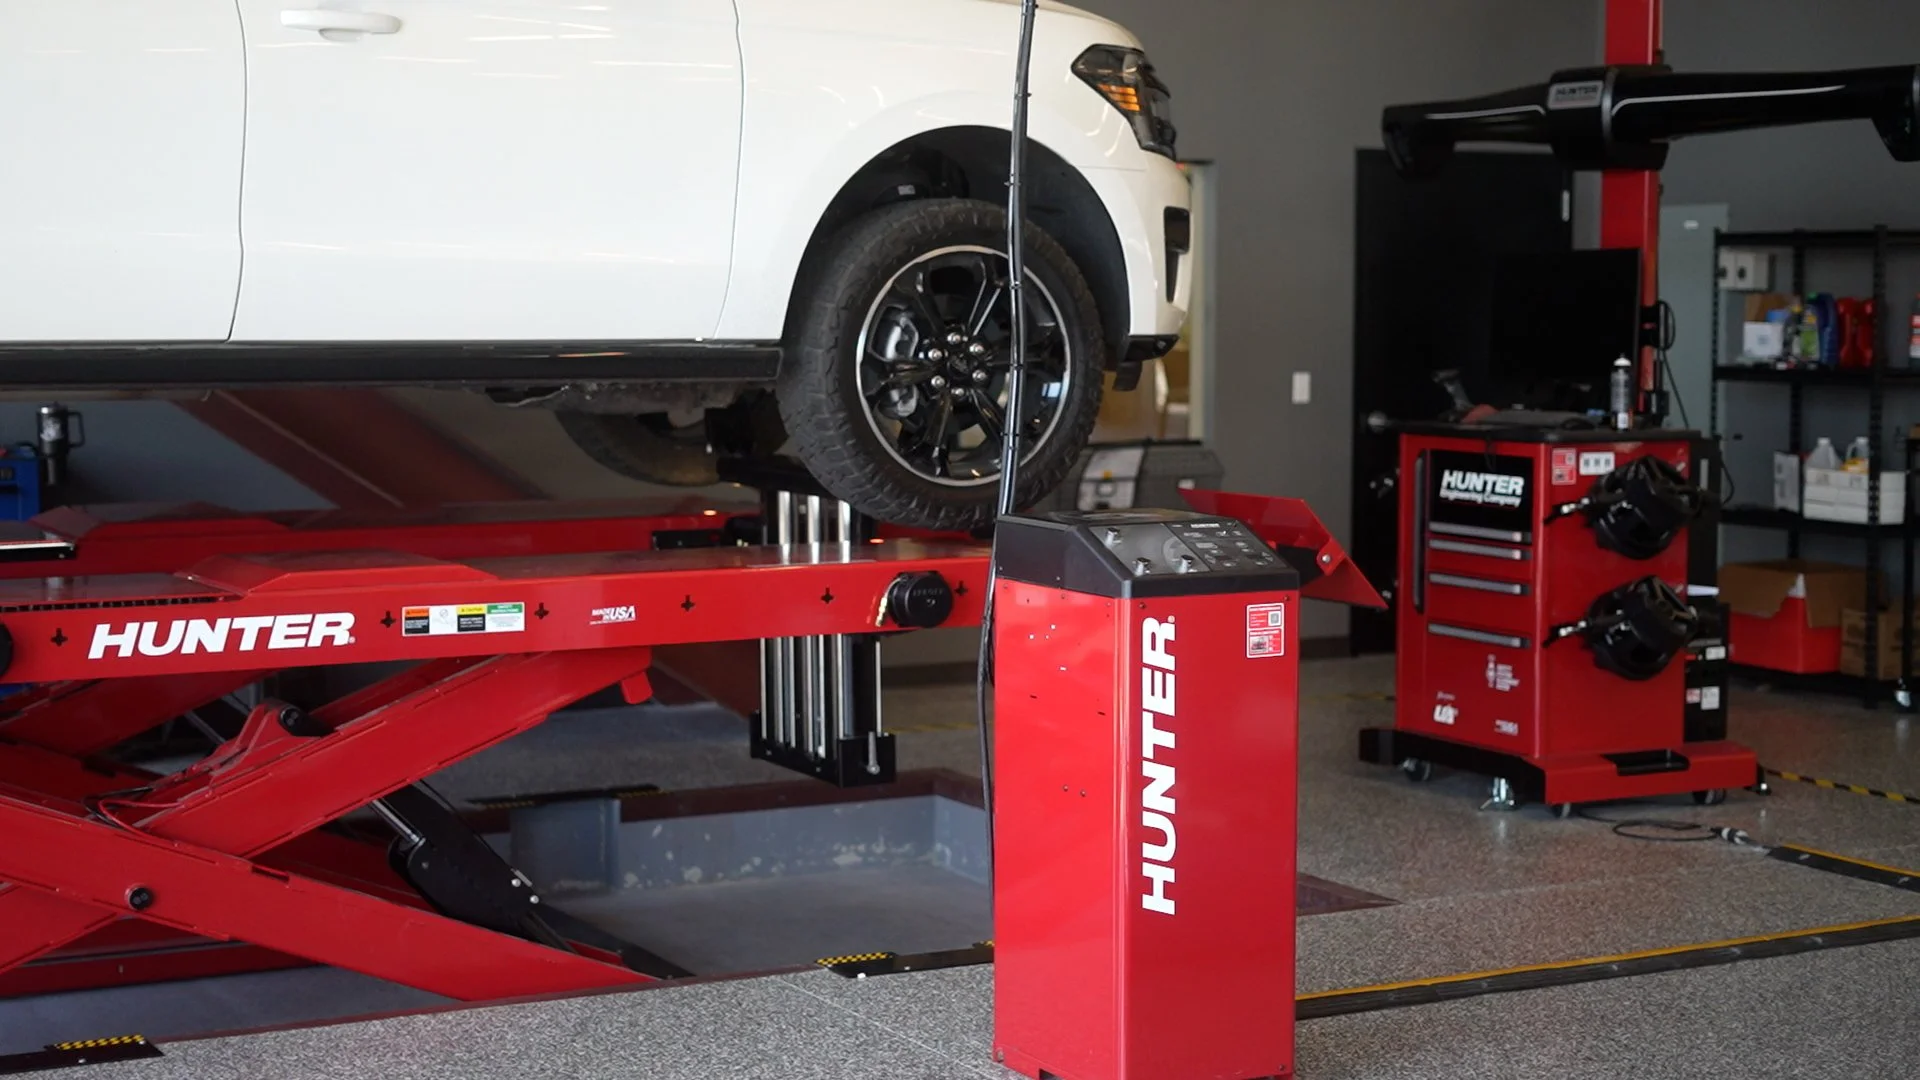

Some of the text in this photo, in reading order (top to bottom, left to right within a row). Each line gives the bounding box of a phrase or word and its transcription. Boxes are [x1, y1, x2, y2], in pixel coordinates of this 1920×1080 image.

[1441, 469, 1524, 495] HUNTER
[609, 605, 635, 621] USA
[88, 613, 355, 660] HUNTER
[1142, 617, 1176, 916] HUNTER
